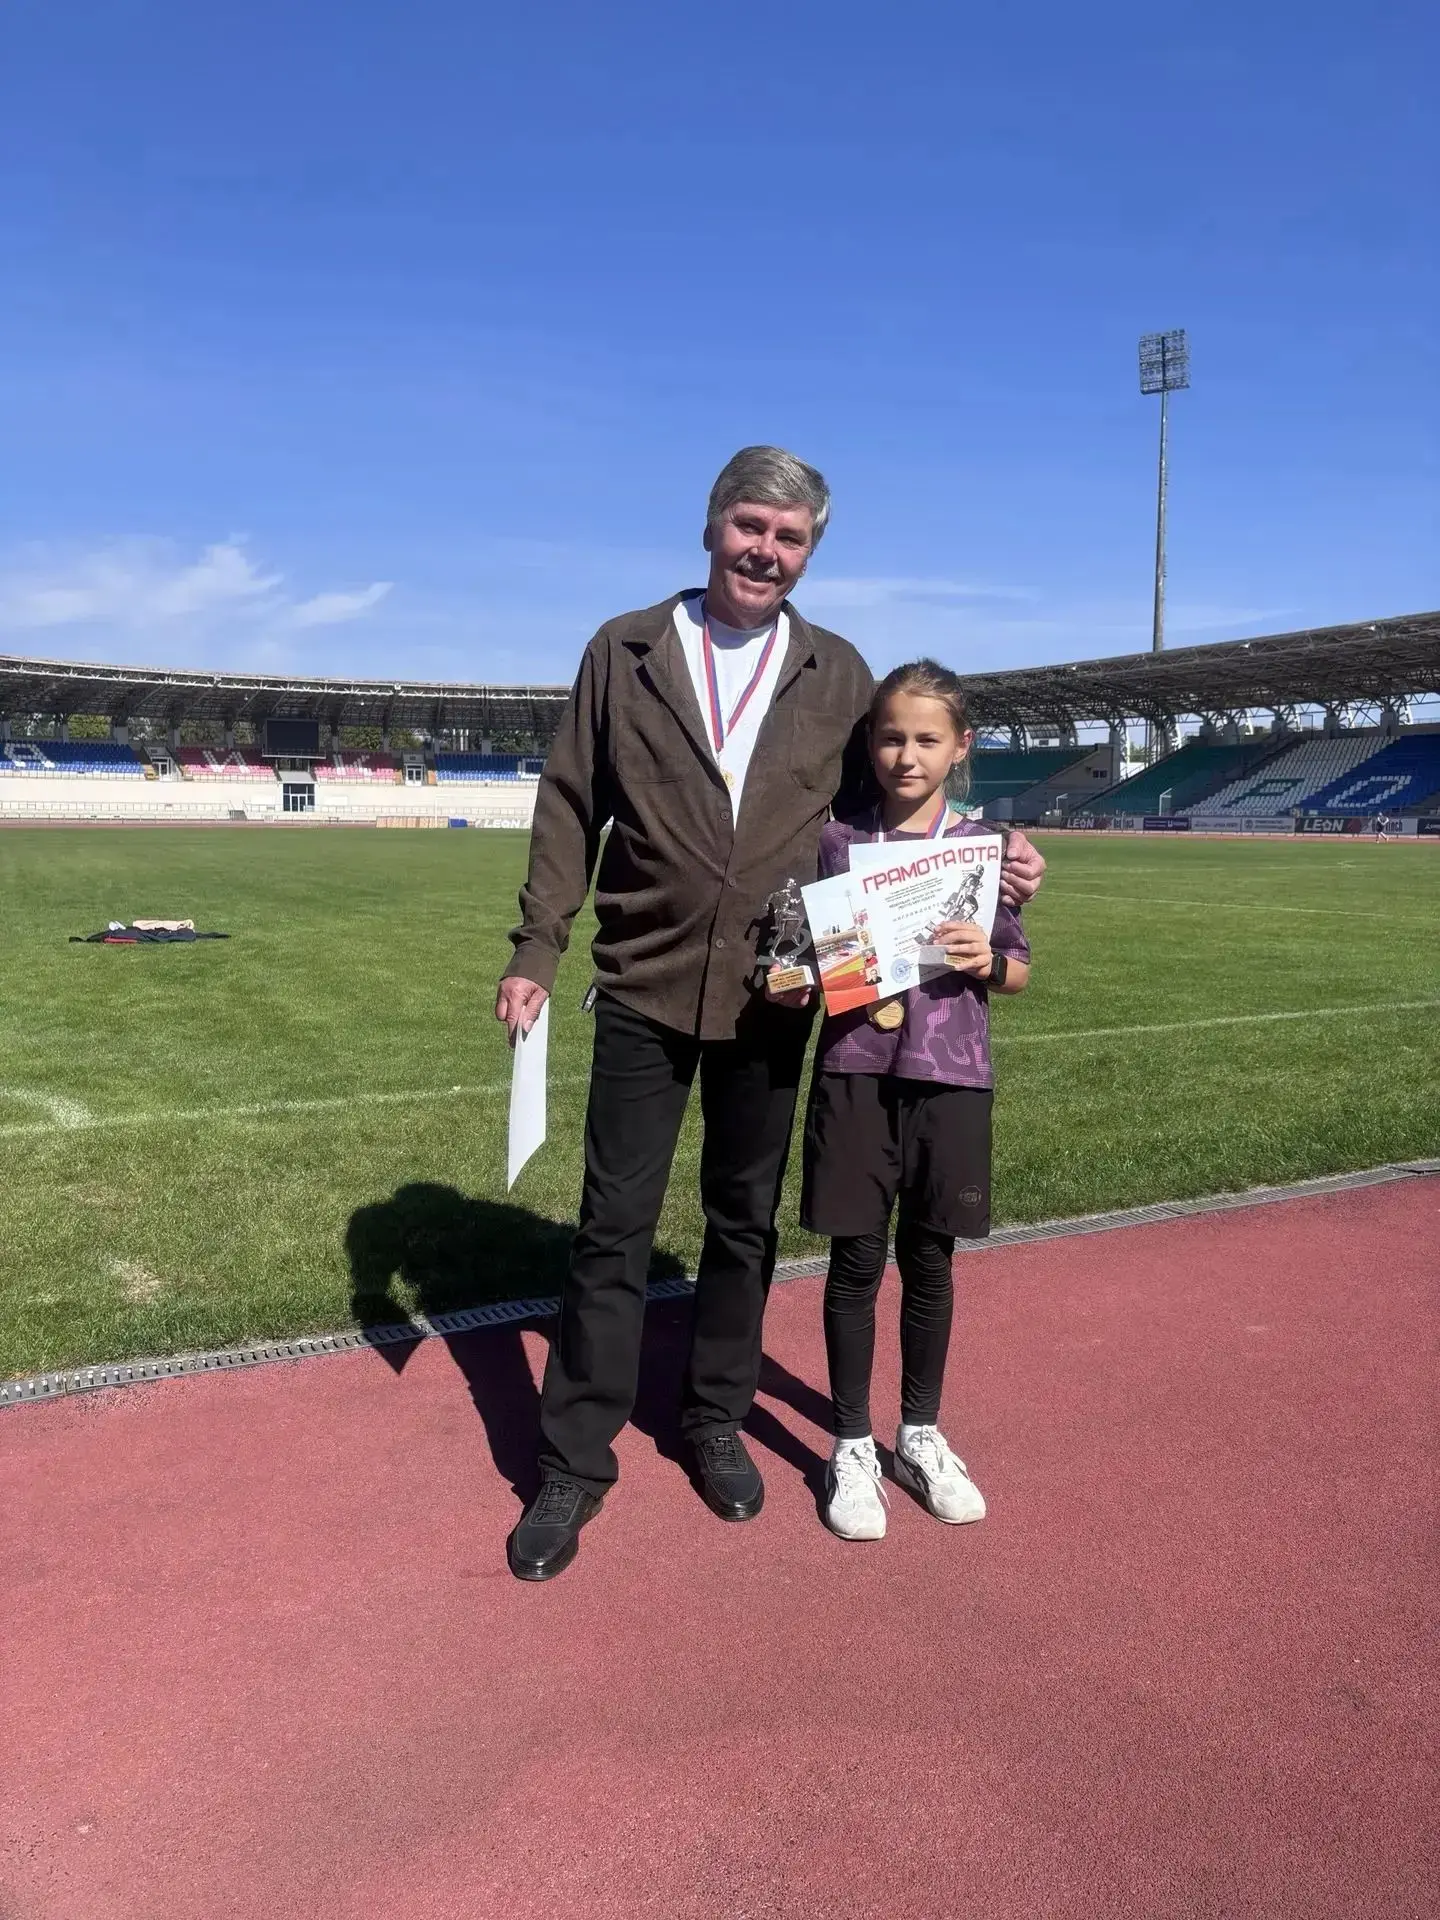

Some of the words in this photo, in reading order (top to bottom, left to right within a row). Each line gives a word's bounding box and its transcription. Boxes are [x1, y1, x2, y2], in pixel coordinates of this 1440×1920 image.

[484, 819, 521, 829] LEON
[1066, 817, 1095, 829] LEON
[1303, 819, 1345, 832] LEON
[862, 849, 957, 894] ГРАМОТА
